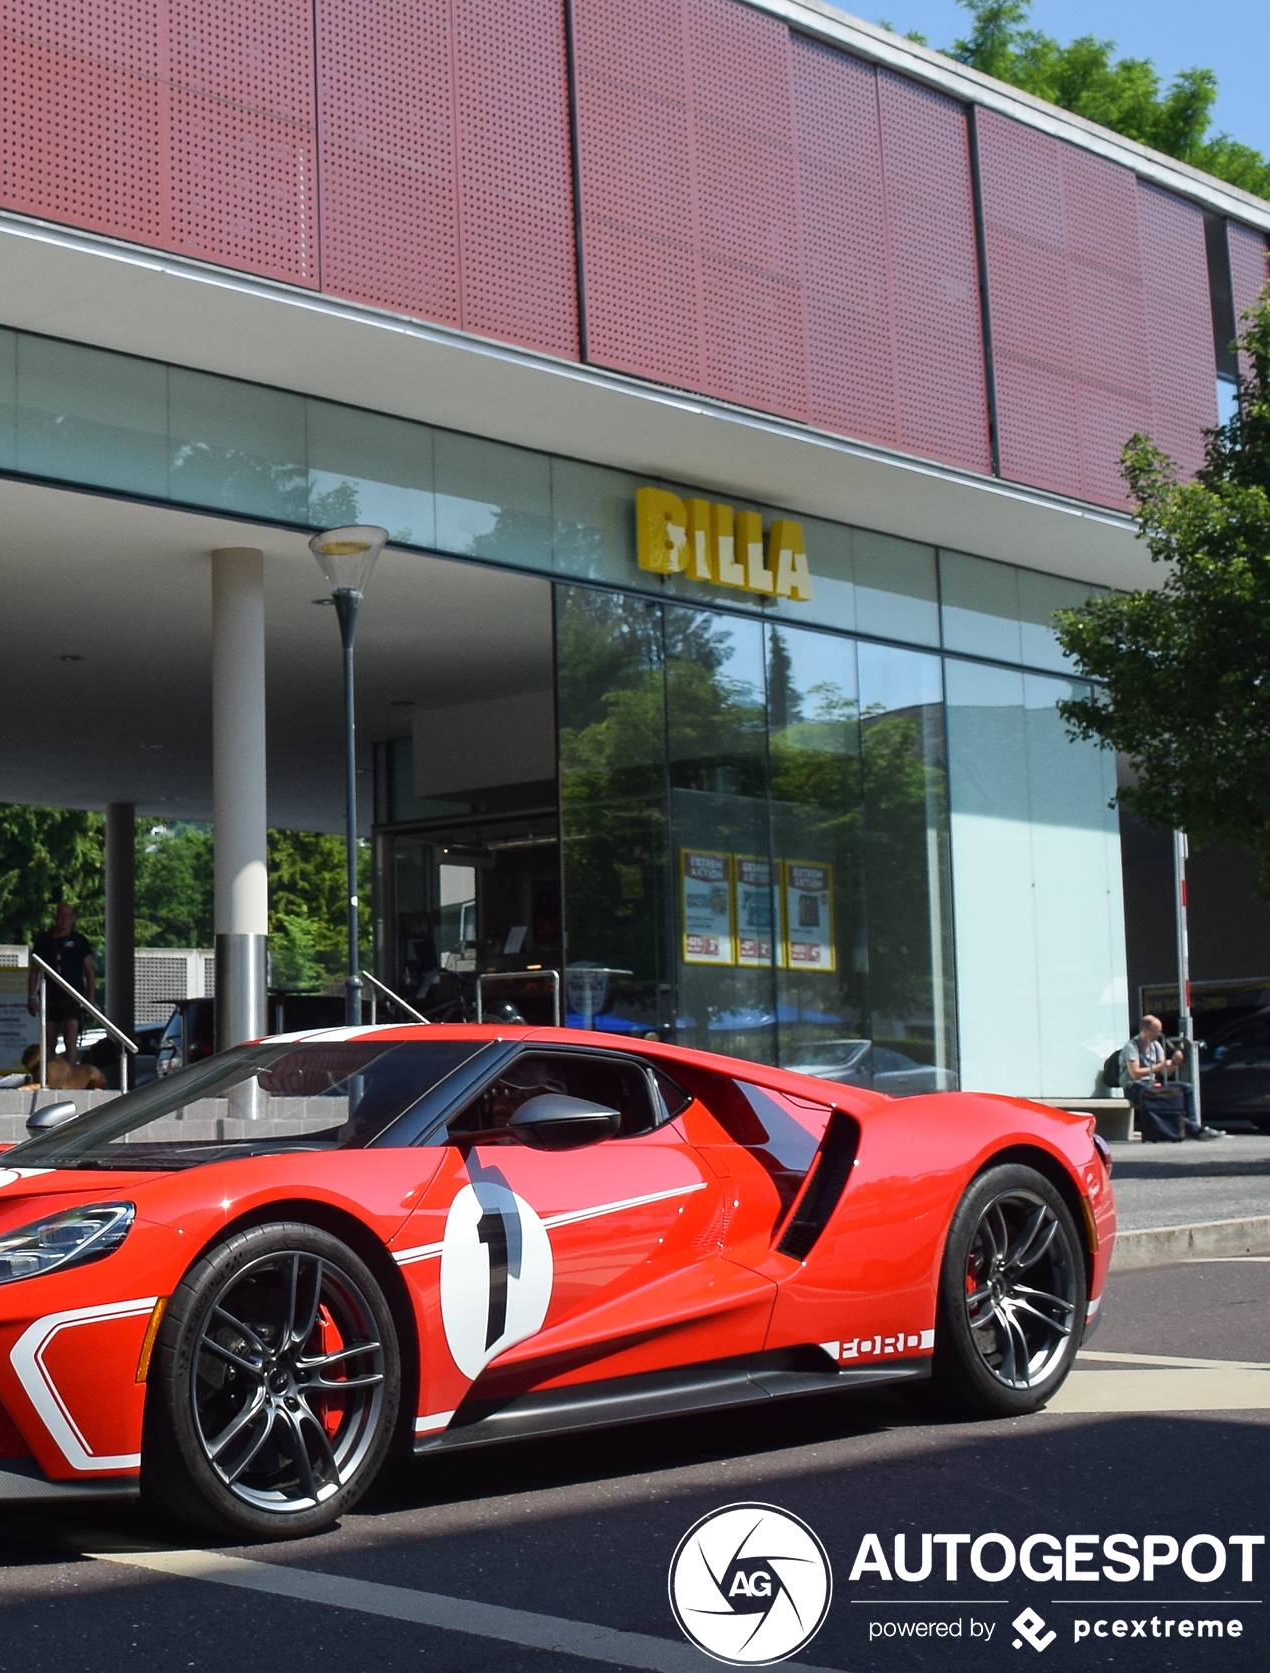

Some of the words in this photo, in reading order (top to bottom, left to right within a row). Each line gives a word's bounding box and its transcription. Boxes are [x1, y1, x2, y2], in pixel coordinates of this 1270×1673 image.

[636, 486, 813, 602] BILLA
[477, 1206, 508, 1353] 1
[838, 1331, 924, 1361] FORD
